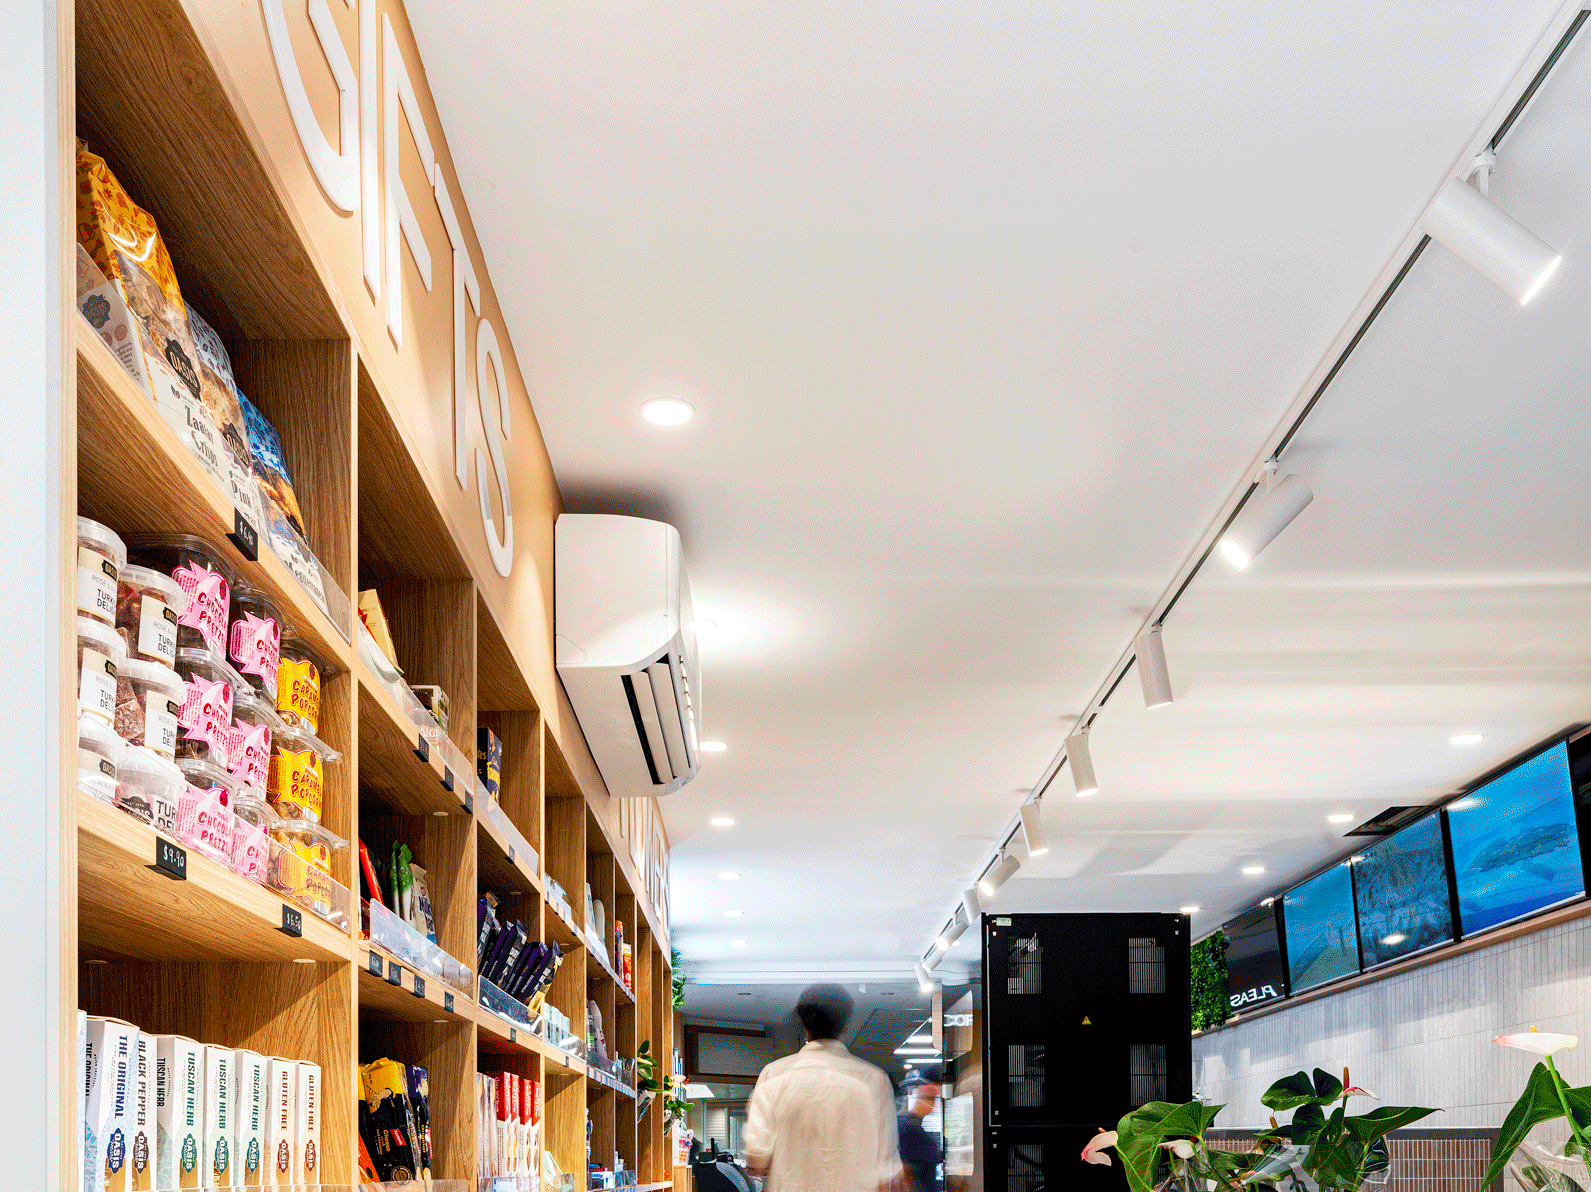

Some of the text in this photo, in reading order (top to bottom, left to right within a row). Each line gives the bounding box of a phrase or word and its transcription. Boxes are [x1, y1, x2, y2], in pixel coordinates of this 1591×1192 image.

[258, 0, 514, 577] GIFTS
[170, 351, 199, 391] OASIS
[162, 843, 186, 868] $9.90
[619, 797, 672, 945] LOWERS
[114, 1034, 128, 1120] THE ORIGINAL
[137, 1040, 147, 1126] BLACK PEPPER
[186, 1051, 196, 1127] TUSCAN HERB
[218, 1059, 227, 1129] TUSCAN HERB
[251, 1104, 259, 1131] HERB
[280, 1108, 288, 1132] FREE
[307, 1110, 315, 1132] FREE
[112, 1133, 122, 1169] OASIS
[137, 1136, 145, 1170] OASIS
[185, 1137, 194, 1171] OASIS
